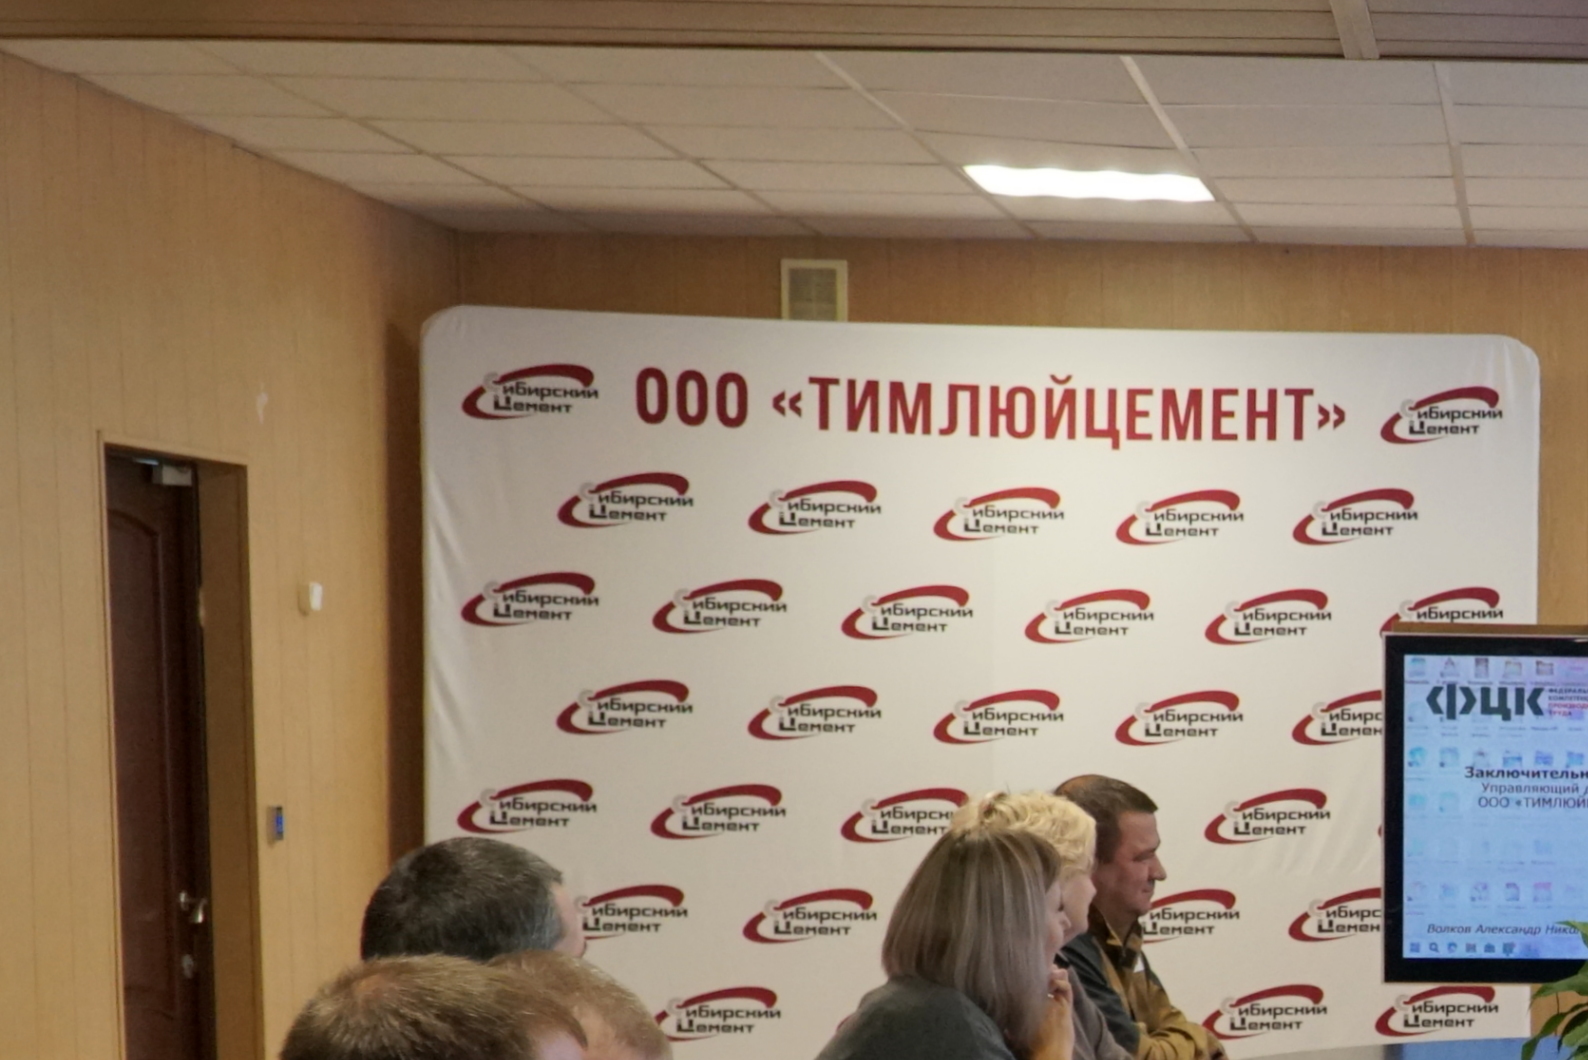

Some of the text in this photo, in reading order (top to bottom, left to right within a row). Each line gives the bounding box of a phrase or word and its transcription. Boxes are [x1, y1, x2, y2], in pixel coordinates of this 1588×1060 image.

[493, 395, 572, 413] Цемент
[635, 366, 1346, 450] ООО «ТИМЛЮЙЦЕМЕНТ»
[1409, 419, 1479, 434] Цемент
[589, 504, 667, 521] Цемент
[780, 513, 856, 530] Цемент
[965, 518, 1039, 534] Цемент
[1147, 521, 1220, 537] Цемент
[1324, 520, 1395, 535] Цемент
[494, 604, 573, 622] Цемент
[684, 610, 761, 627] Цемент
[873, 616, 948, 633] Цемент
[1056, 621, 1129, 637] Цемент
[1236, 621, 1308, 637] Цемент
[589, 711, 667, 729] Цемент
[1311, 701, 1382, 725] Сибирс
[780, 717, 856, 734] Цемент
[965, 721, 1039, 737] Цемент
[1147, 723, 1219, 738] Цемент
[1321, 722, 1382, 736] Цемен
[1481, 782, 1579, 797] Управляющий
[861, 798, 951, 822] Сибирск
[1478, 796, 1510, 809] ООО
[491, 809, 570, 827] Цемент
[683, 815, 760, 833] Цемент
[871, 820, 947, 835] Цемент
[1234, 820, 1306, 835] Цемент
[1150, 907, 1240, 923] ибирский
[1309, 899, 1381, 921] Сибирс
[584, 915, 662, 933] Цемент
[775, 919, 851, 936] Цемент
[1317, 919, 1381, 933] Цемен
[1427, 923, 1471, 934] Волков
[1475, 924, 1541, 936] Александр
[678, 1016, 755, 1033] Цемент
[1231, 1015, 1303, 1030] Цемент
[1405, 1014, 1475, 1029] Цемент
